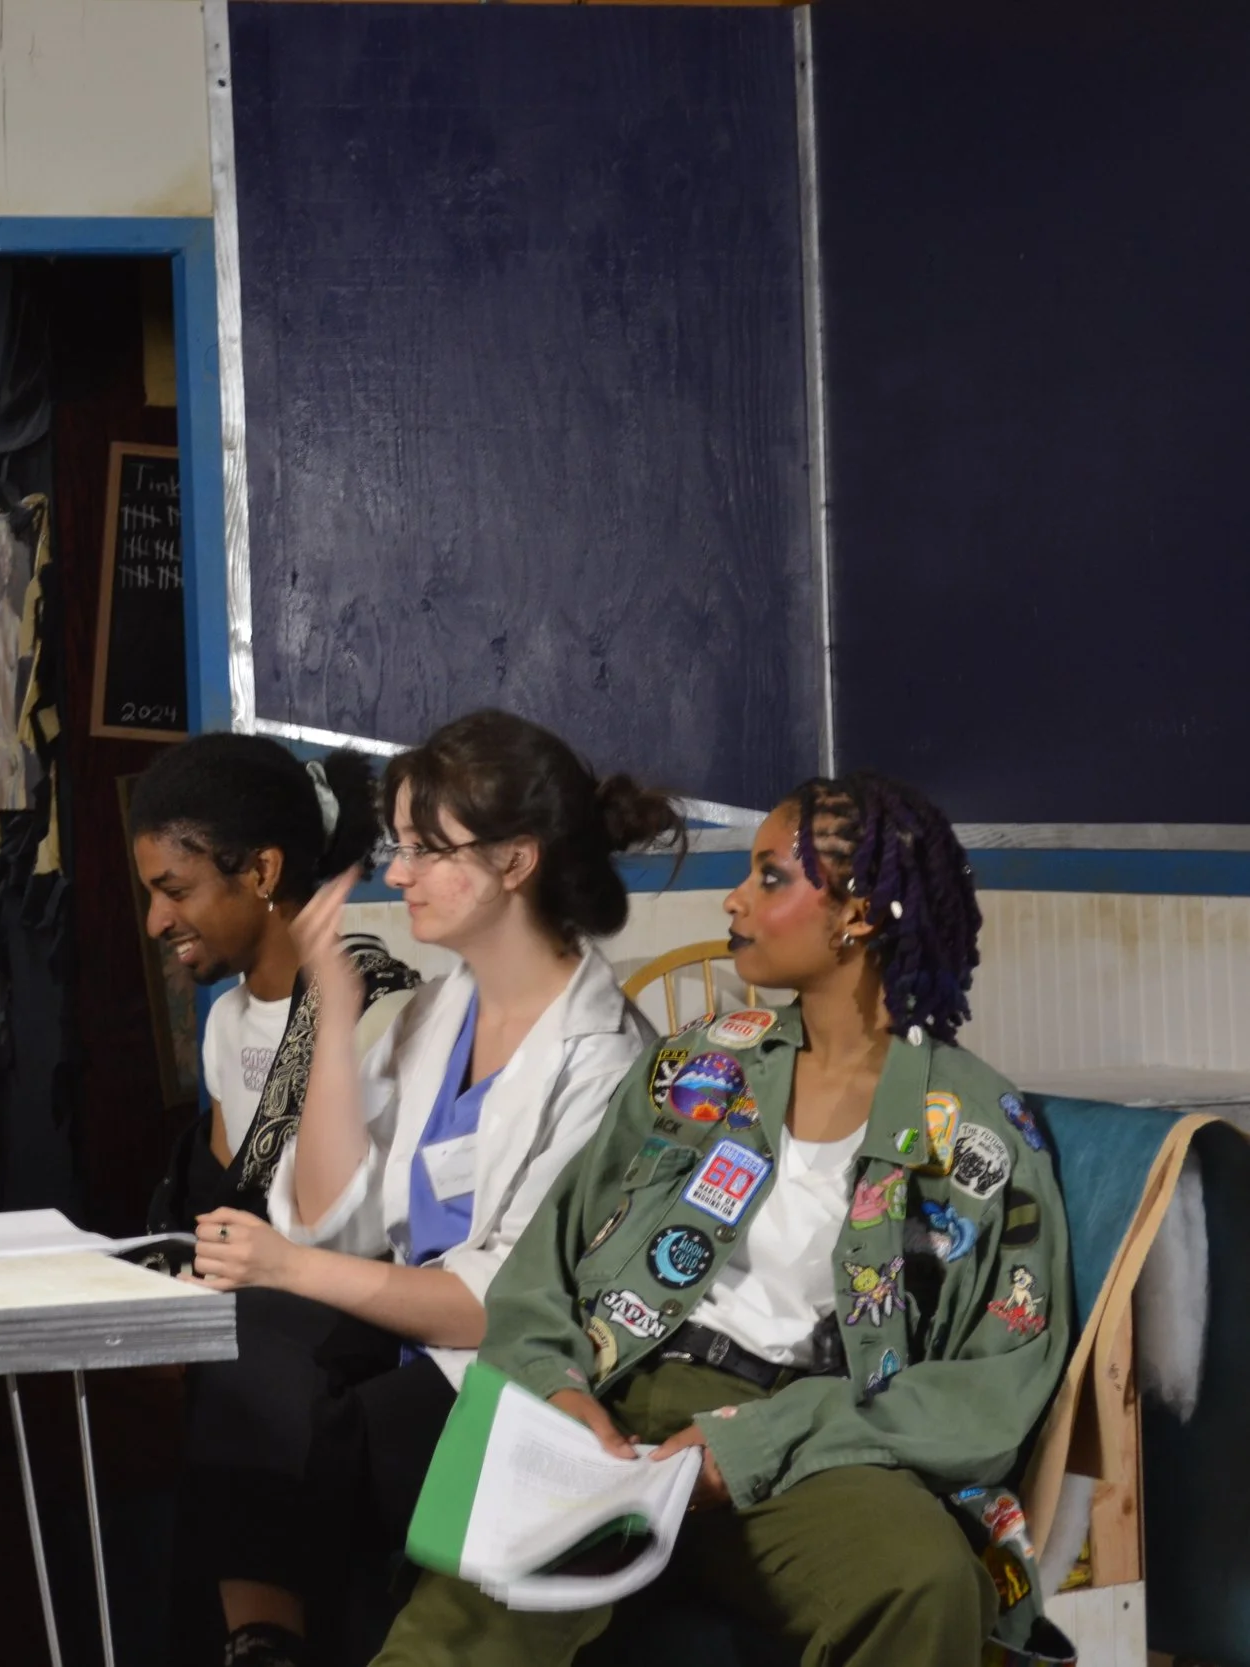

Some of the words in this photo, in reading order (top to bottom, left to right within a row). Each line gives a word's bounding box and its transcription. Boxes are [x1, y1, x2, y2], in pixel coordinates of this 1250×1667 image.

[120, 702, 177, 722] 2024
[702, 1156, 756, 1200] 60
[673, 1249, 699, 1269] CHILD
[678, 1239, 705, 1259] MOON
[603, 1291, 667, 1339] JAPAN
